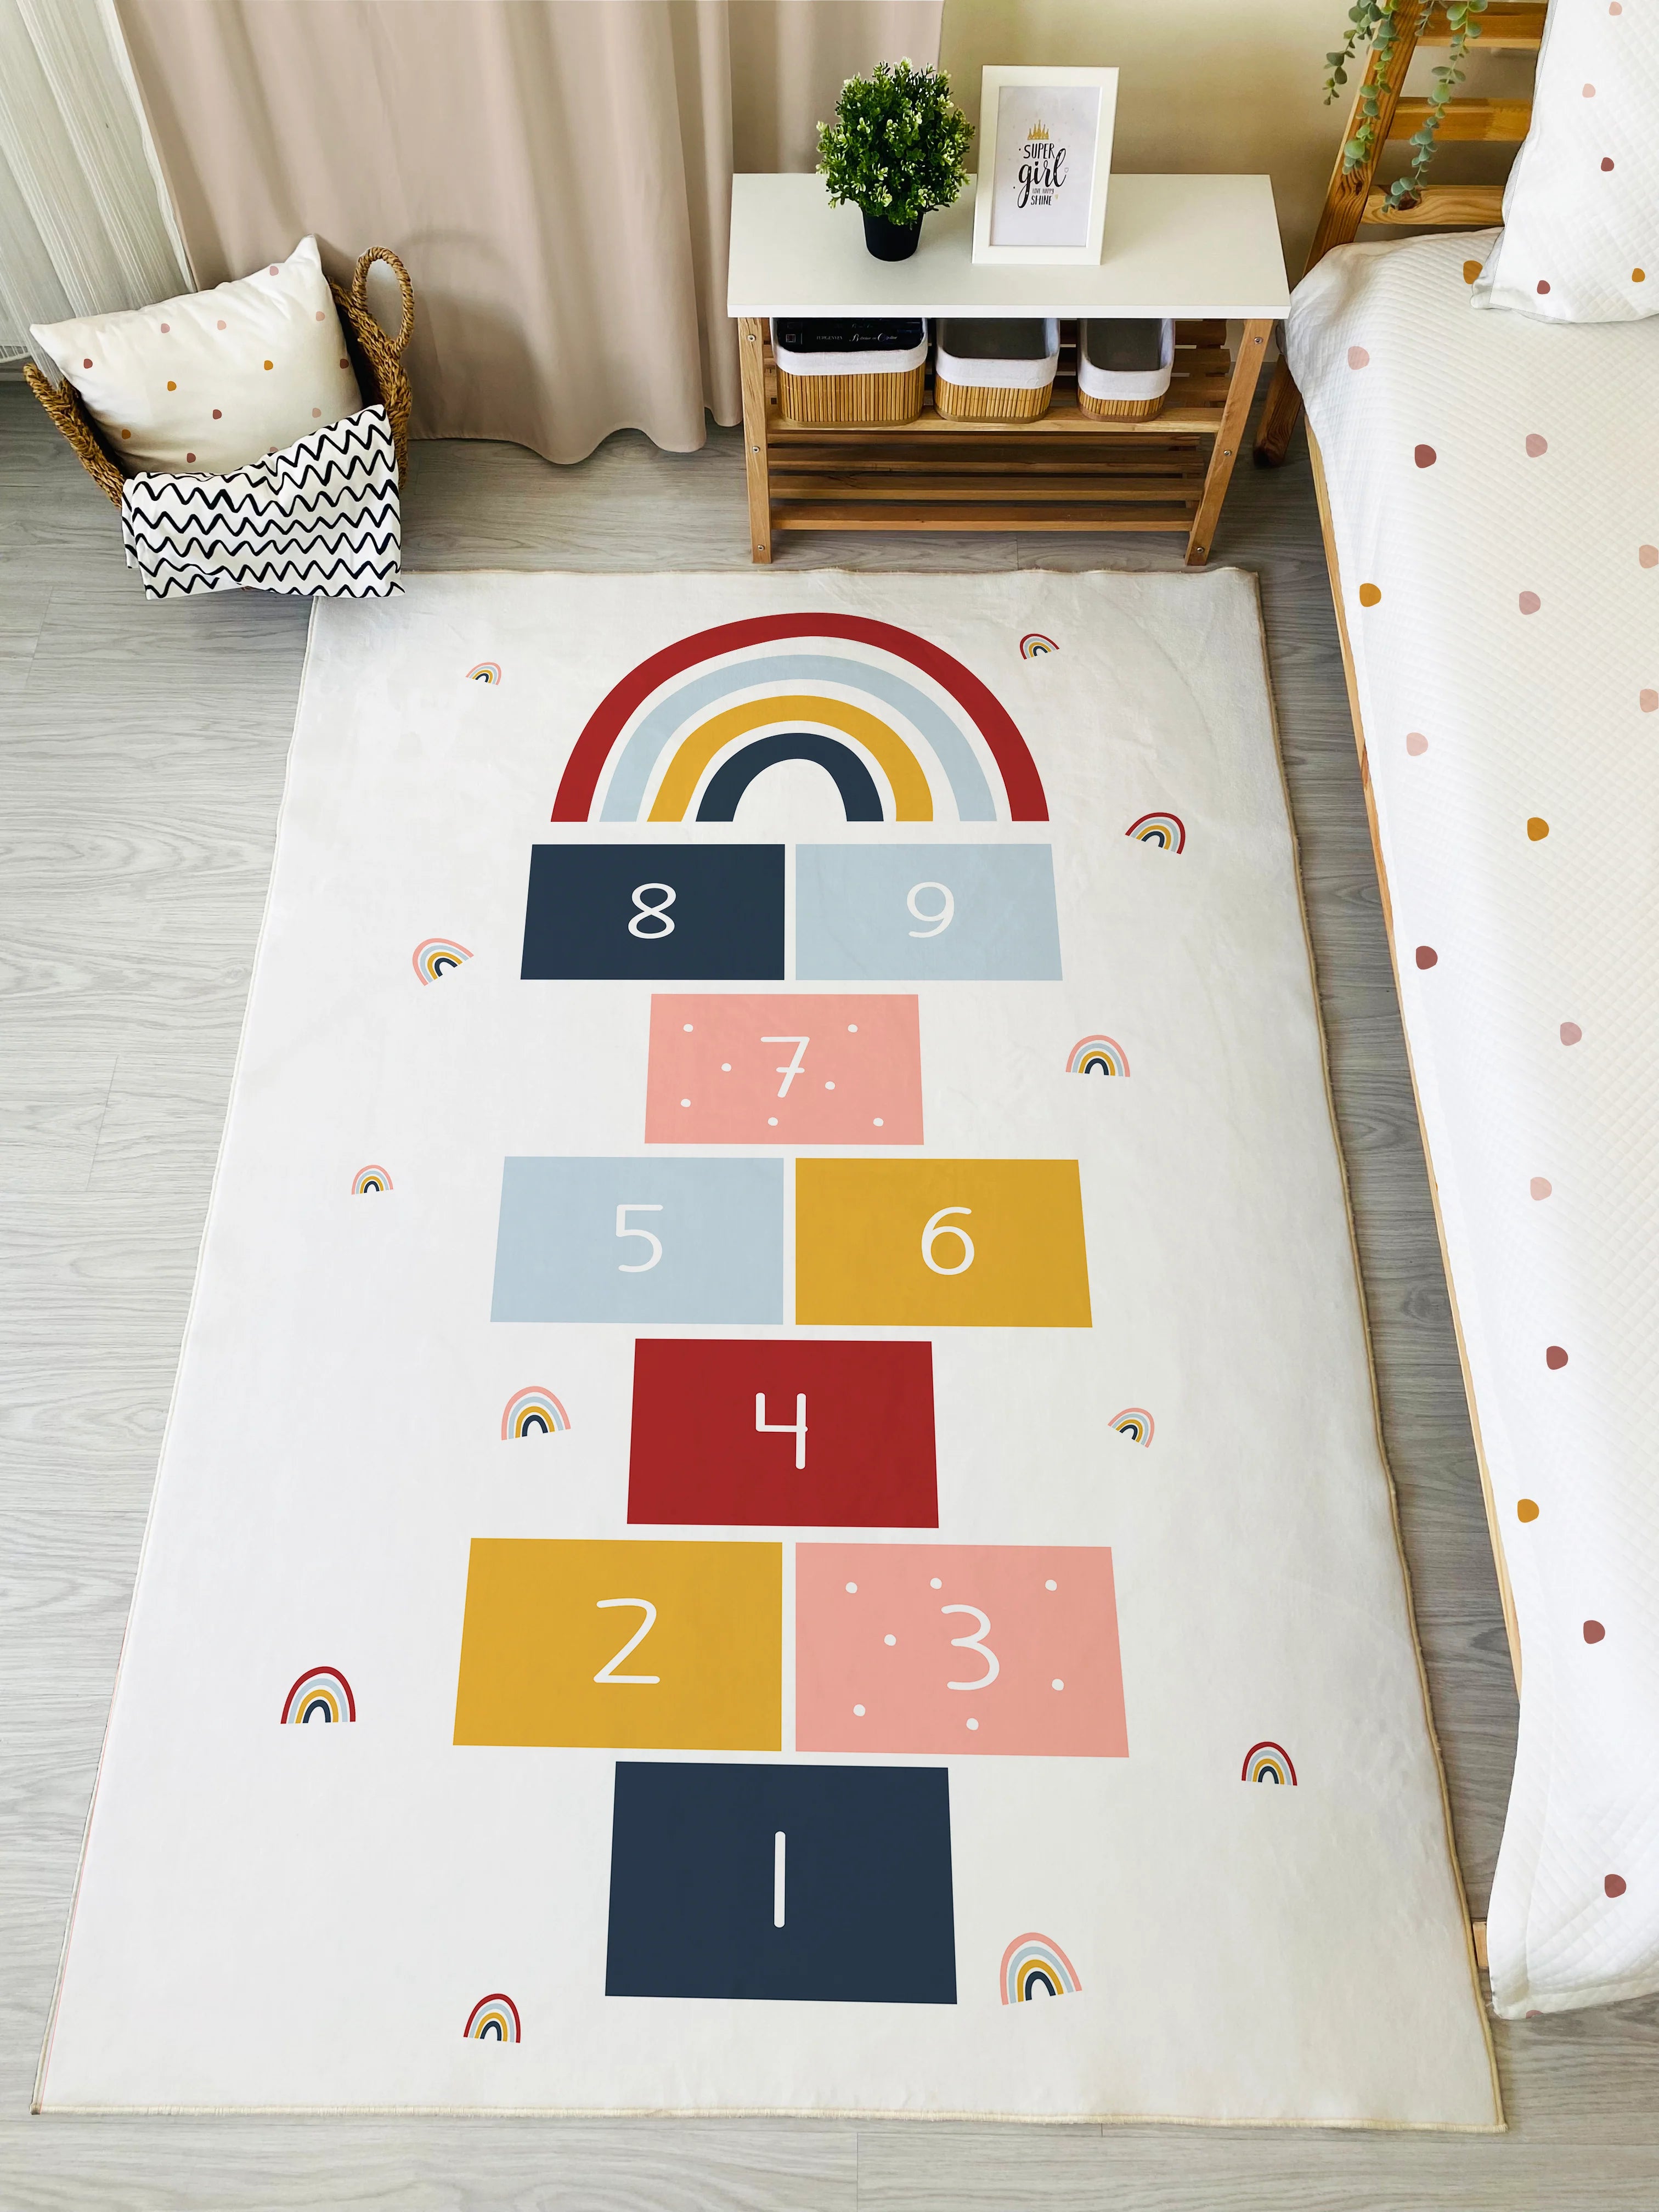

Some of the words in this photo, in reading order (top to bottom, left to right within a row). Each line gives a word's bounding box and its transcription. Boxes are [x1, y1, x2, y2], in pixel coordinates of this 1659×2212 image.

[1017, 148, 1066, 208] girl
[1023, 143, 1055, 159] SUPER
[1030, 195, 1052, 205] SHINE
[628, 883, 676, 939] 8
[906, 882, 955, 938] 9
[760, 1036, 810, 1098] 7
[616, 1204, 663, 1273] 5
[921, 1206, 975, 1276] 6
[755, 1392, 808, 1470] 4
[593, 1598, 661, 1684] 2
[941, 1604, 1000, 1690] 3
[774, 1831, 786, 1928] 1
